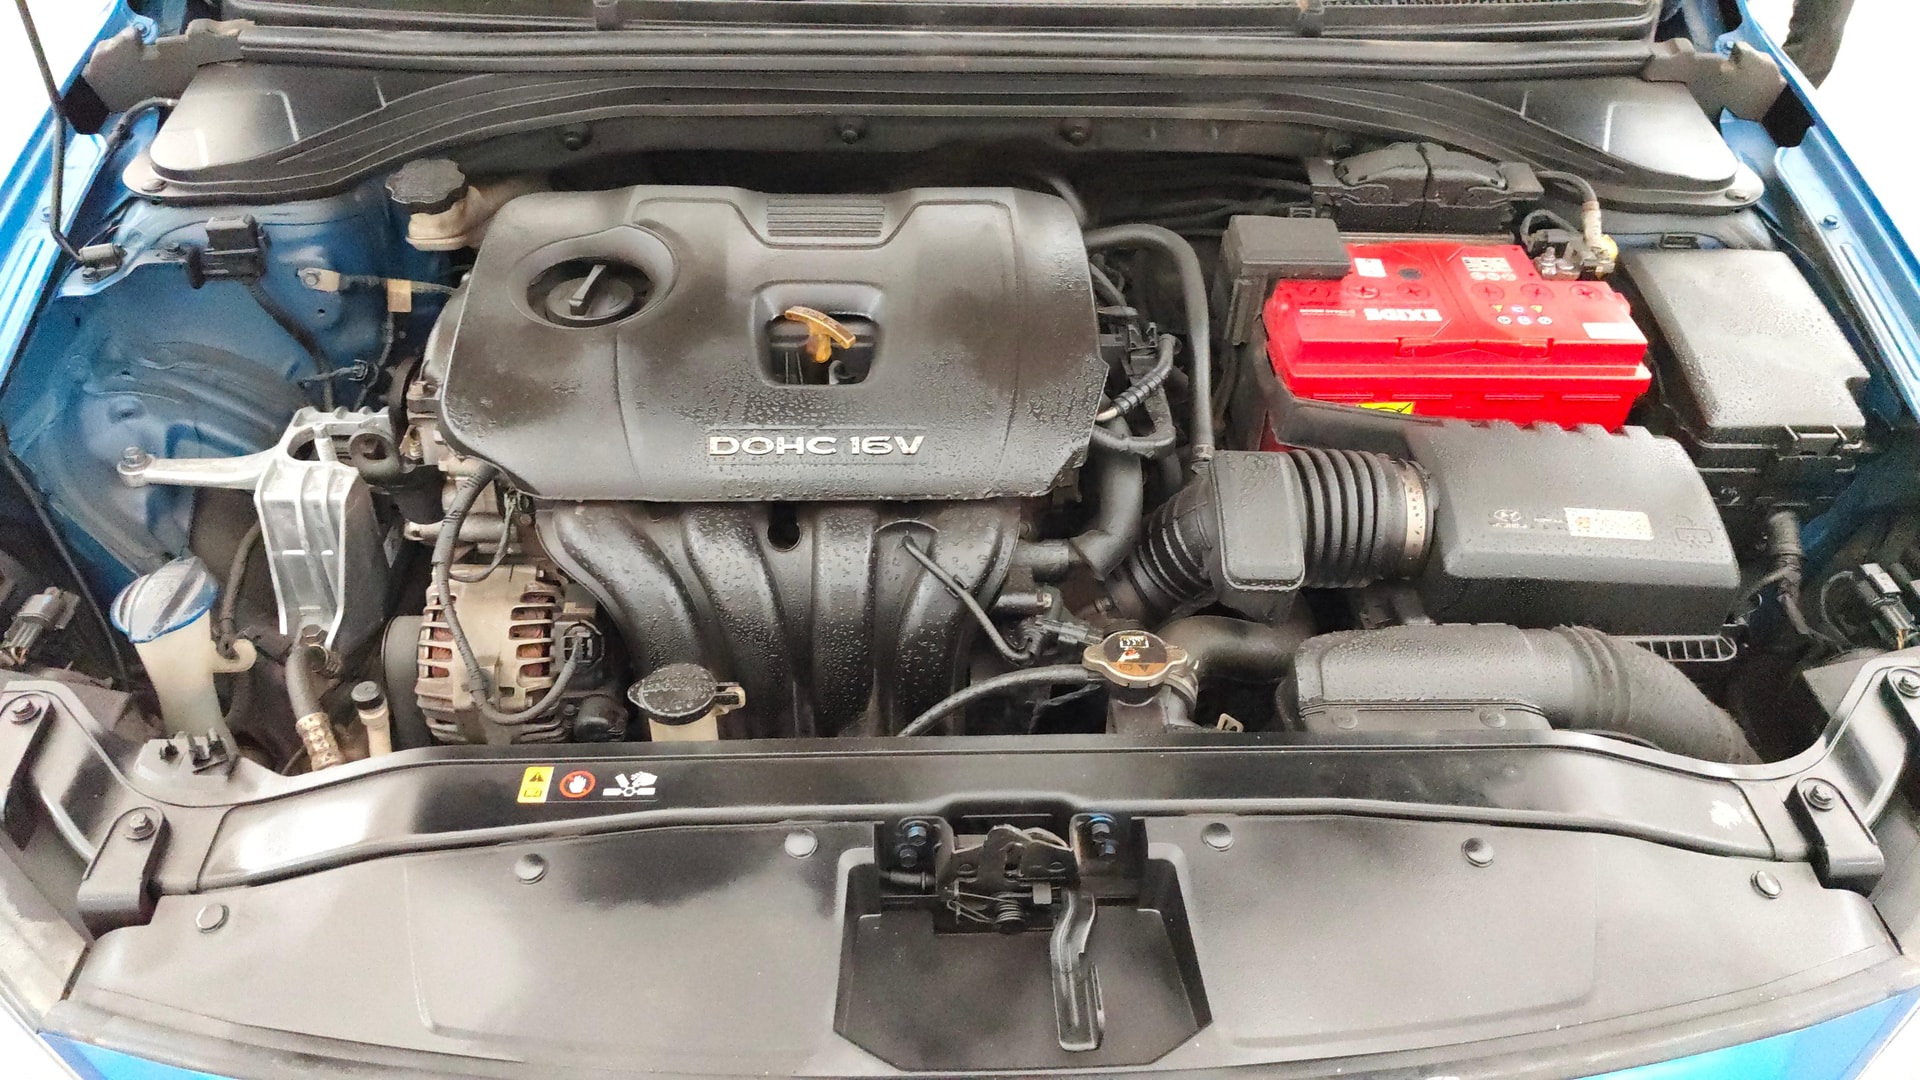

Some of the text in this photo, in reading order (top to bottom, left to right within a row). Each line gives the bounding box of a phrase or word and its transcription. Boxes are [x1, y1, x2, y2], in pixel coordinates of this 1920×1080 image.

[1363, 308, 1442, 321] EXIDE
[709, 436, 925, 455] DOHC 16V
